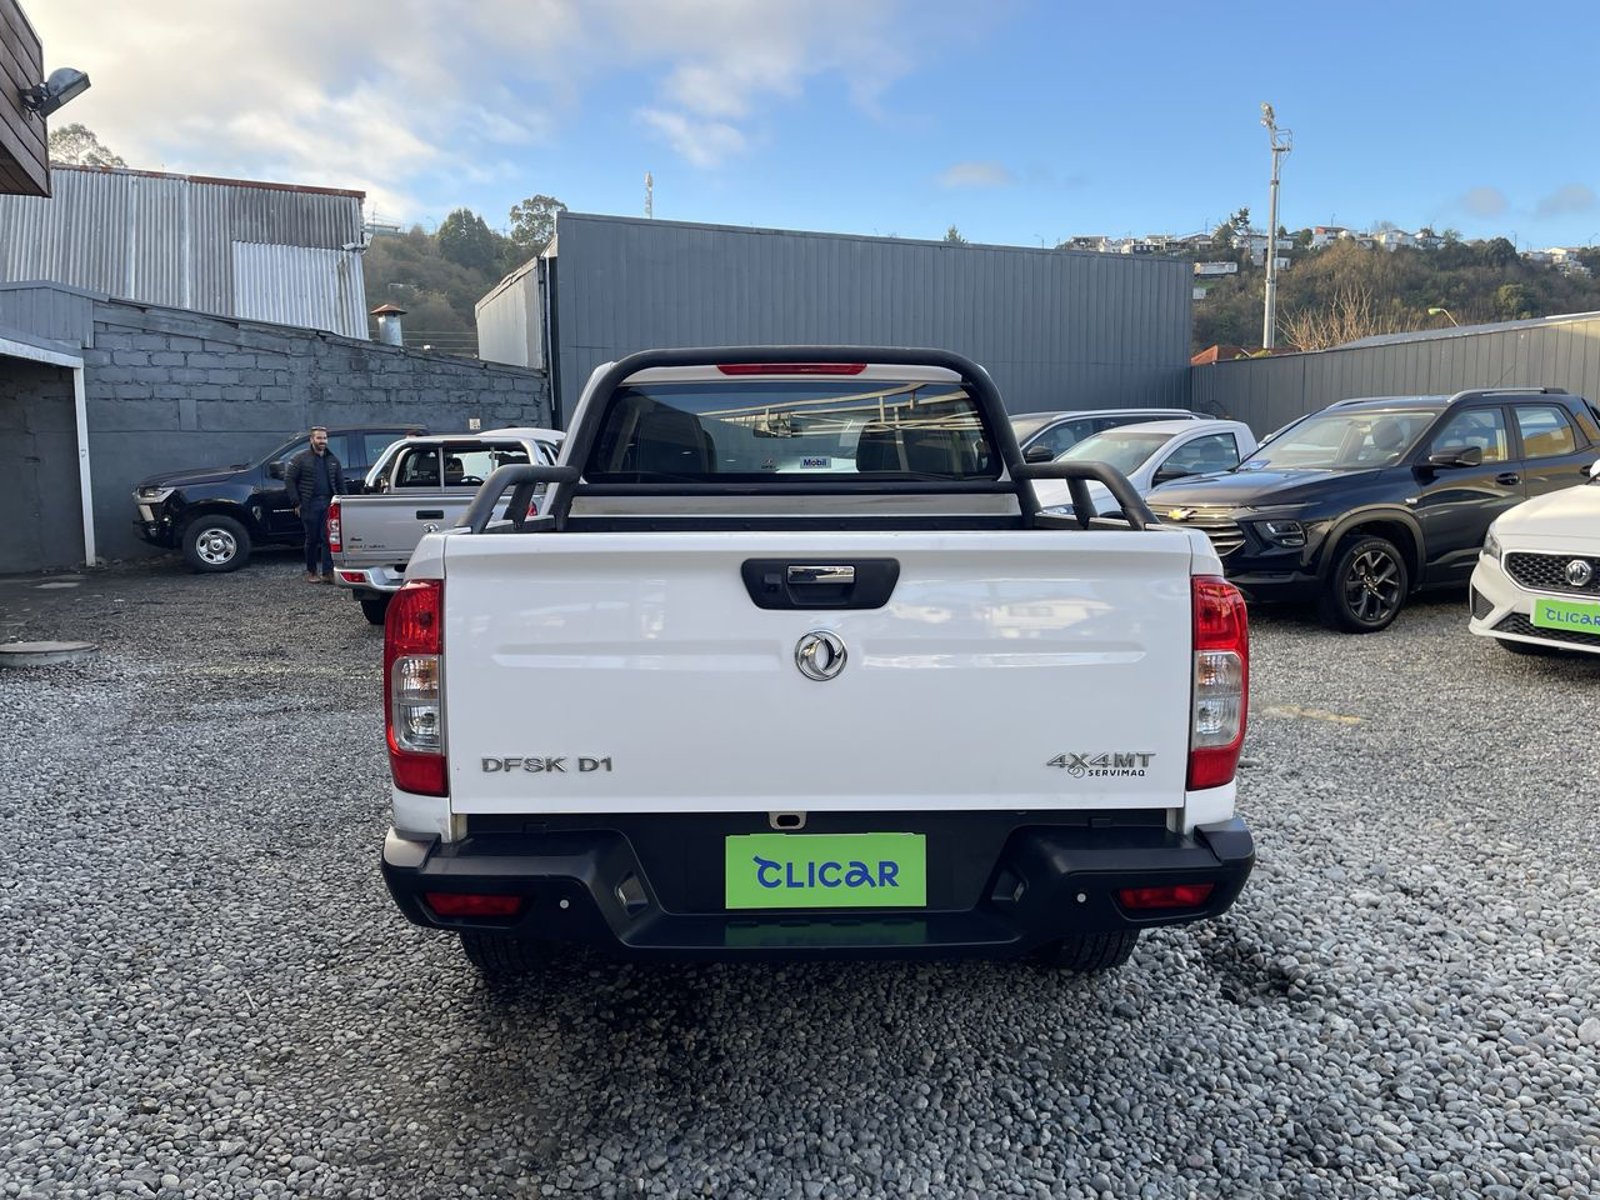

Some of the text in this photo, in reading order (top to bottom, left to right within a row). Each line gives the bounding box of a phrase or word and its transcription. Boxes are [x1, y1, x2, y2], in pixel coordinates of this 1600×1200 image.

[803, 458, 827, 467] Mobil
[481, 757, 612, 773] DFSK D1
[1088, 769, 1145, 777] SERVIMAQ
